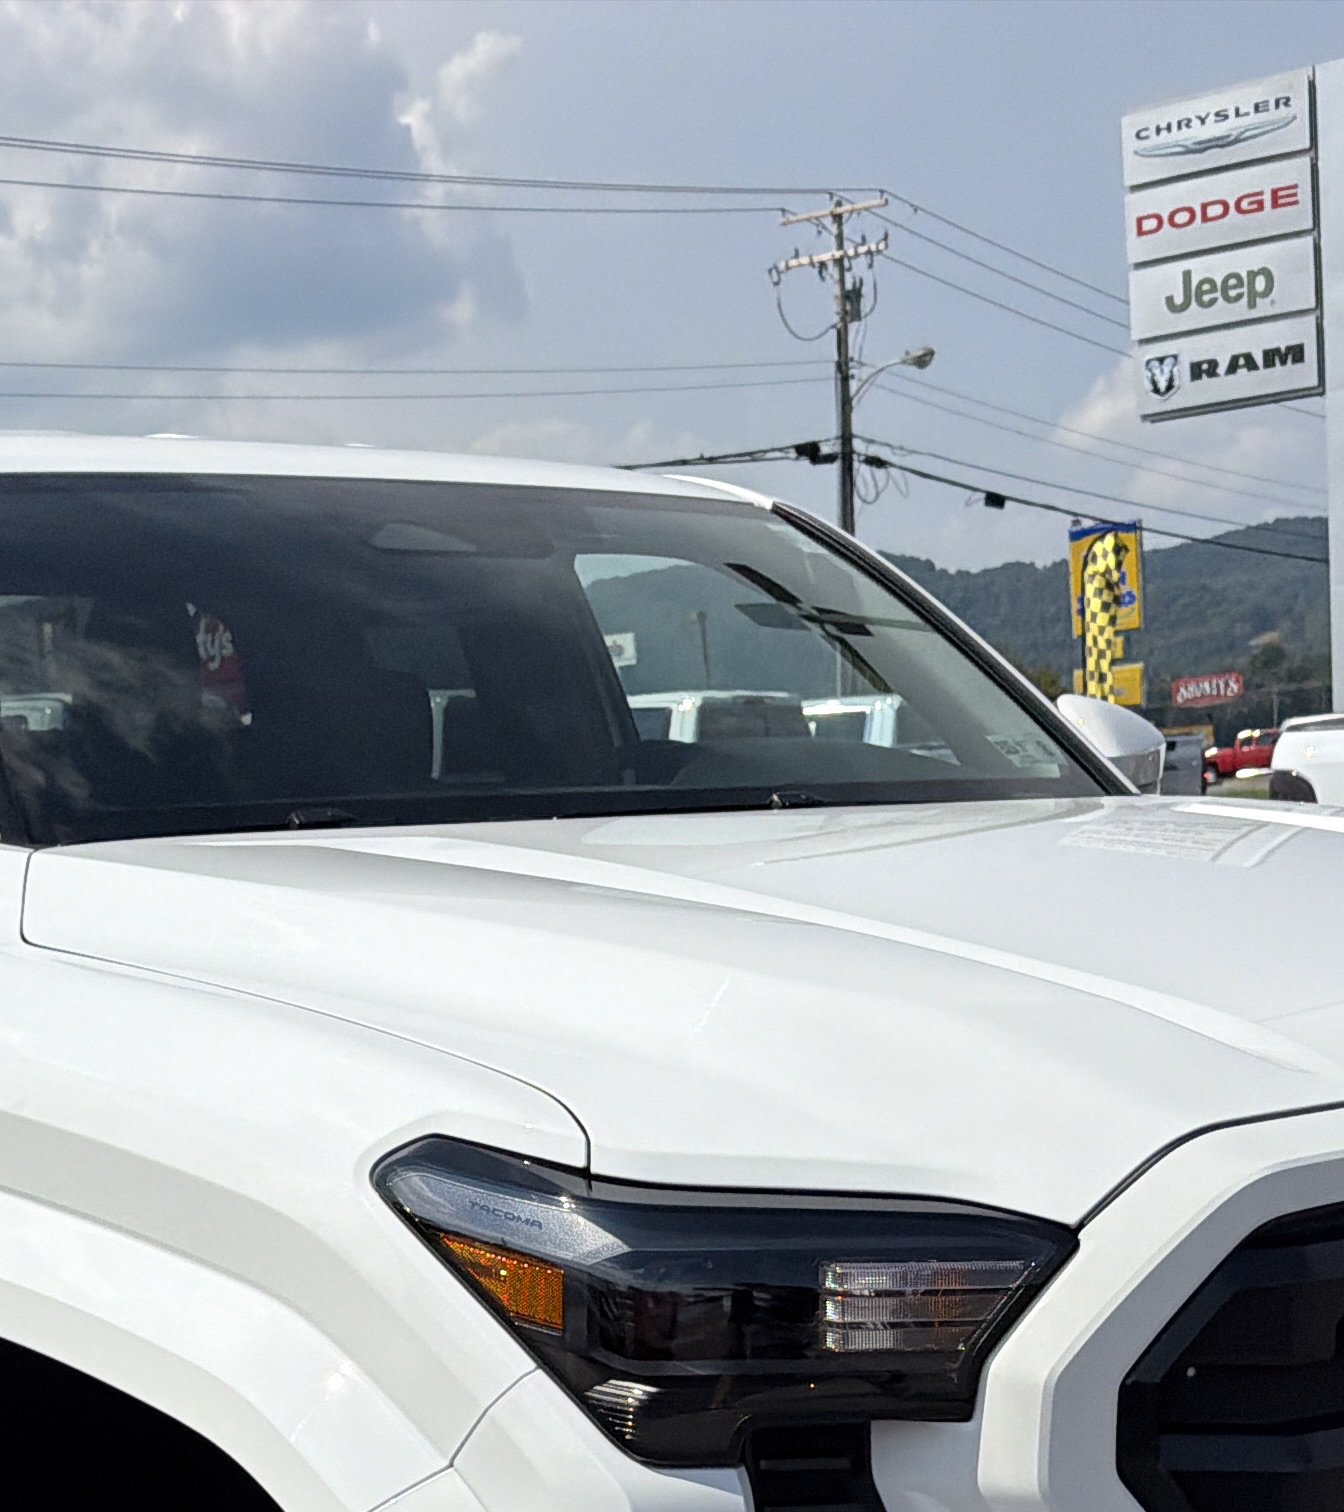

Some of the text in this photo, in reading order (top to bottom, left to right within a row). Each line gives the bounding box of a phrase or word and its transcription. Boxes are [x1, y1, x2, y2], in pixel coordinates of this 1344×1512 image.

[1134, 95, 1293, 142] CHRYSLER
[1135, 183, 1300, 238] DODGE
[1164, 265, 1275, 315] Jeep
[1189, 342, 1306, 383] RAM
[468, 1201, 543, 1230] TACOMA
